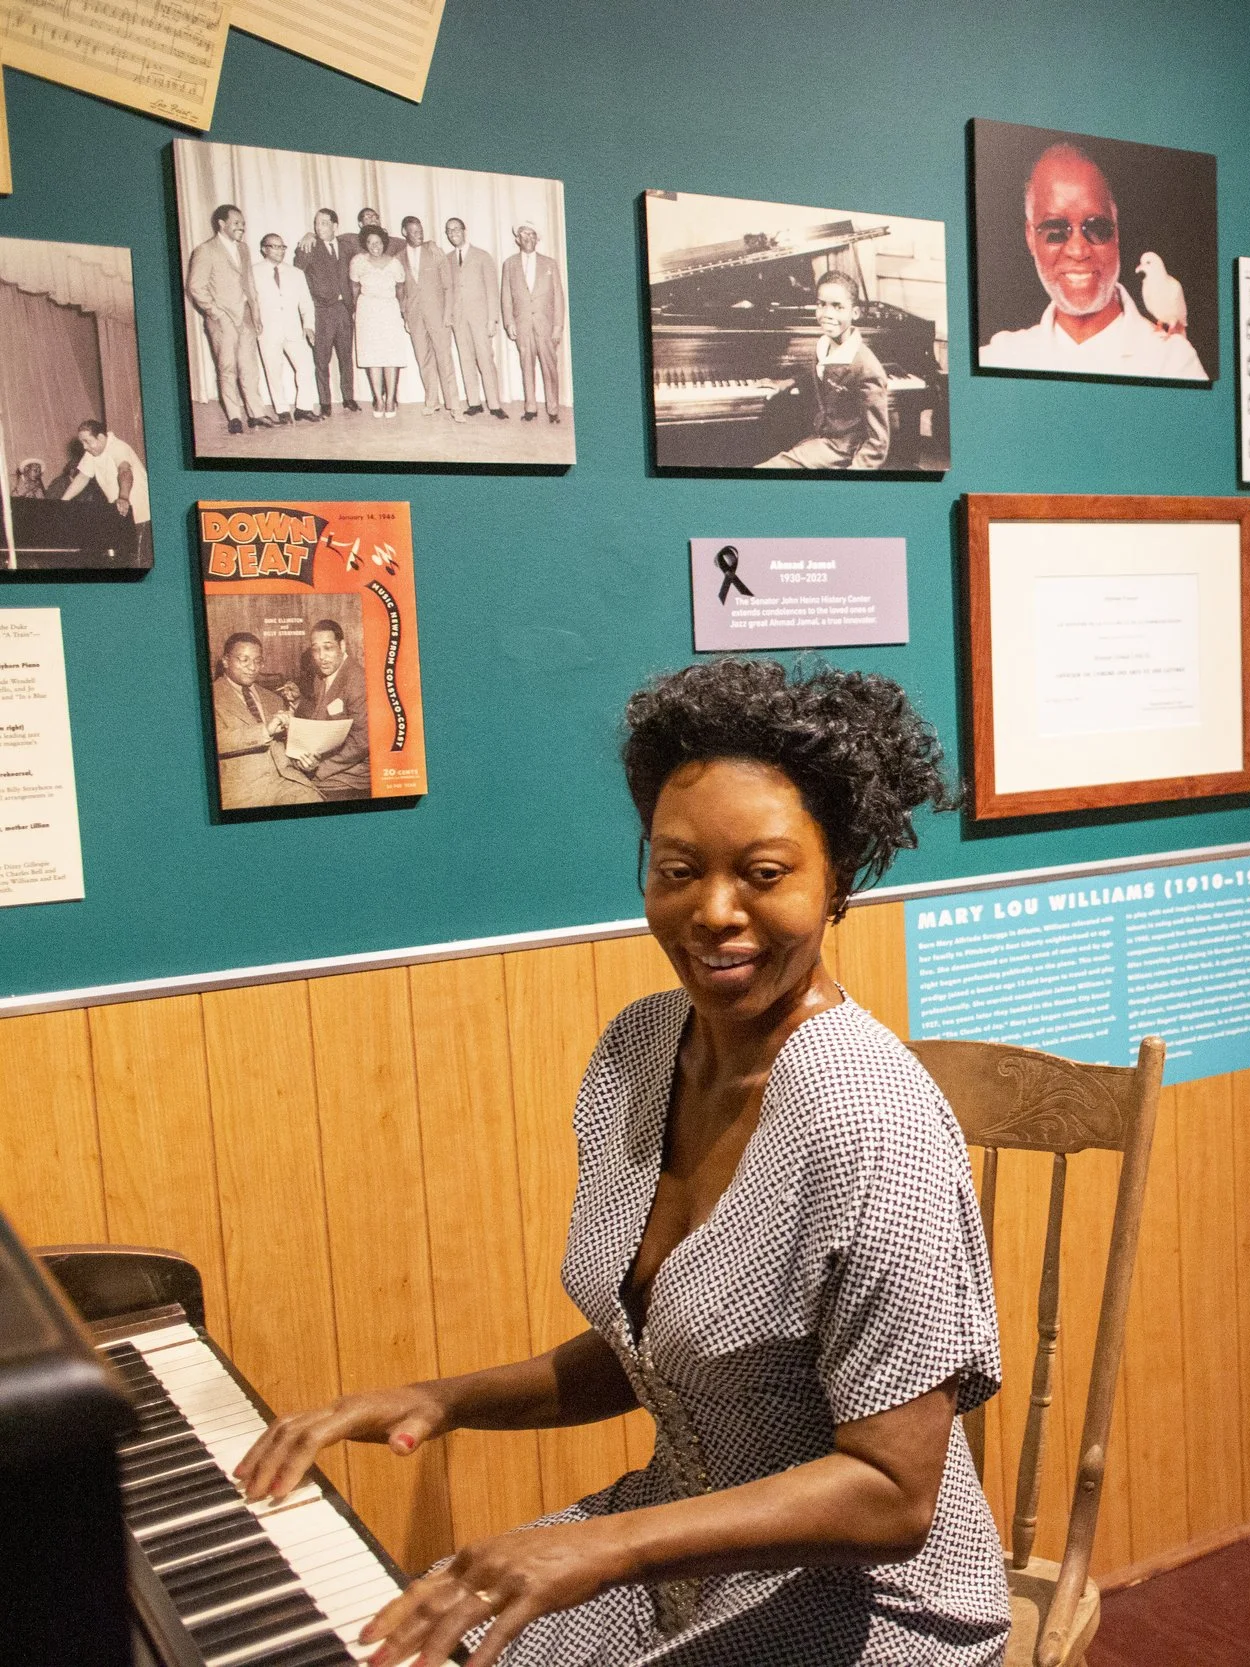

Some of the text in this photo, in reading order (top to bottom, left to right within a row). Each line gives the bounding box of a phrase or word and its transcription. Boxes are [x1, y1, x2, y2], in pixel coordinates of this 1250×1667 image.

[202, 512, 317, 544] DOWN
[209, 543, 309, 577] BEAT
[770, 559, 836, 570] Ahmad Jamal
[371, 583, 394, 608] MUSIC
[735, 597, 749, 606] The
[781, 596, 798, 605] John
[821, 596, 846, 606] History
[816, 606, 828, 614] the
[390, 611, 399, 637] NEWS
[769, 618, 794, 627] Ahmad
[387, 640, 397, 665] FROM
[6, 724, 24, 732] right)
[383, 769, 396, 777] 20
[918, 904, 984, 930] MARY
[994, 898, 1038, 920] LOU
[1048, 882, 1154, 911] WILLIAMS
